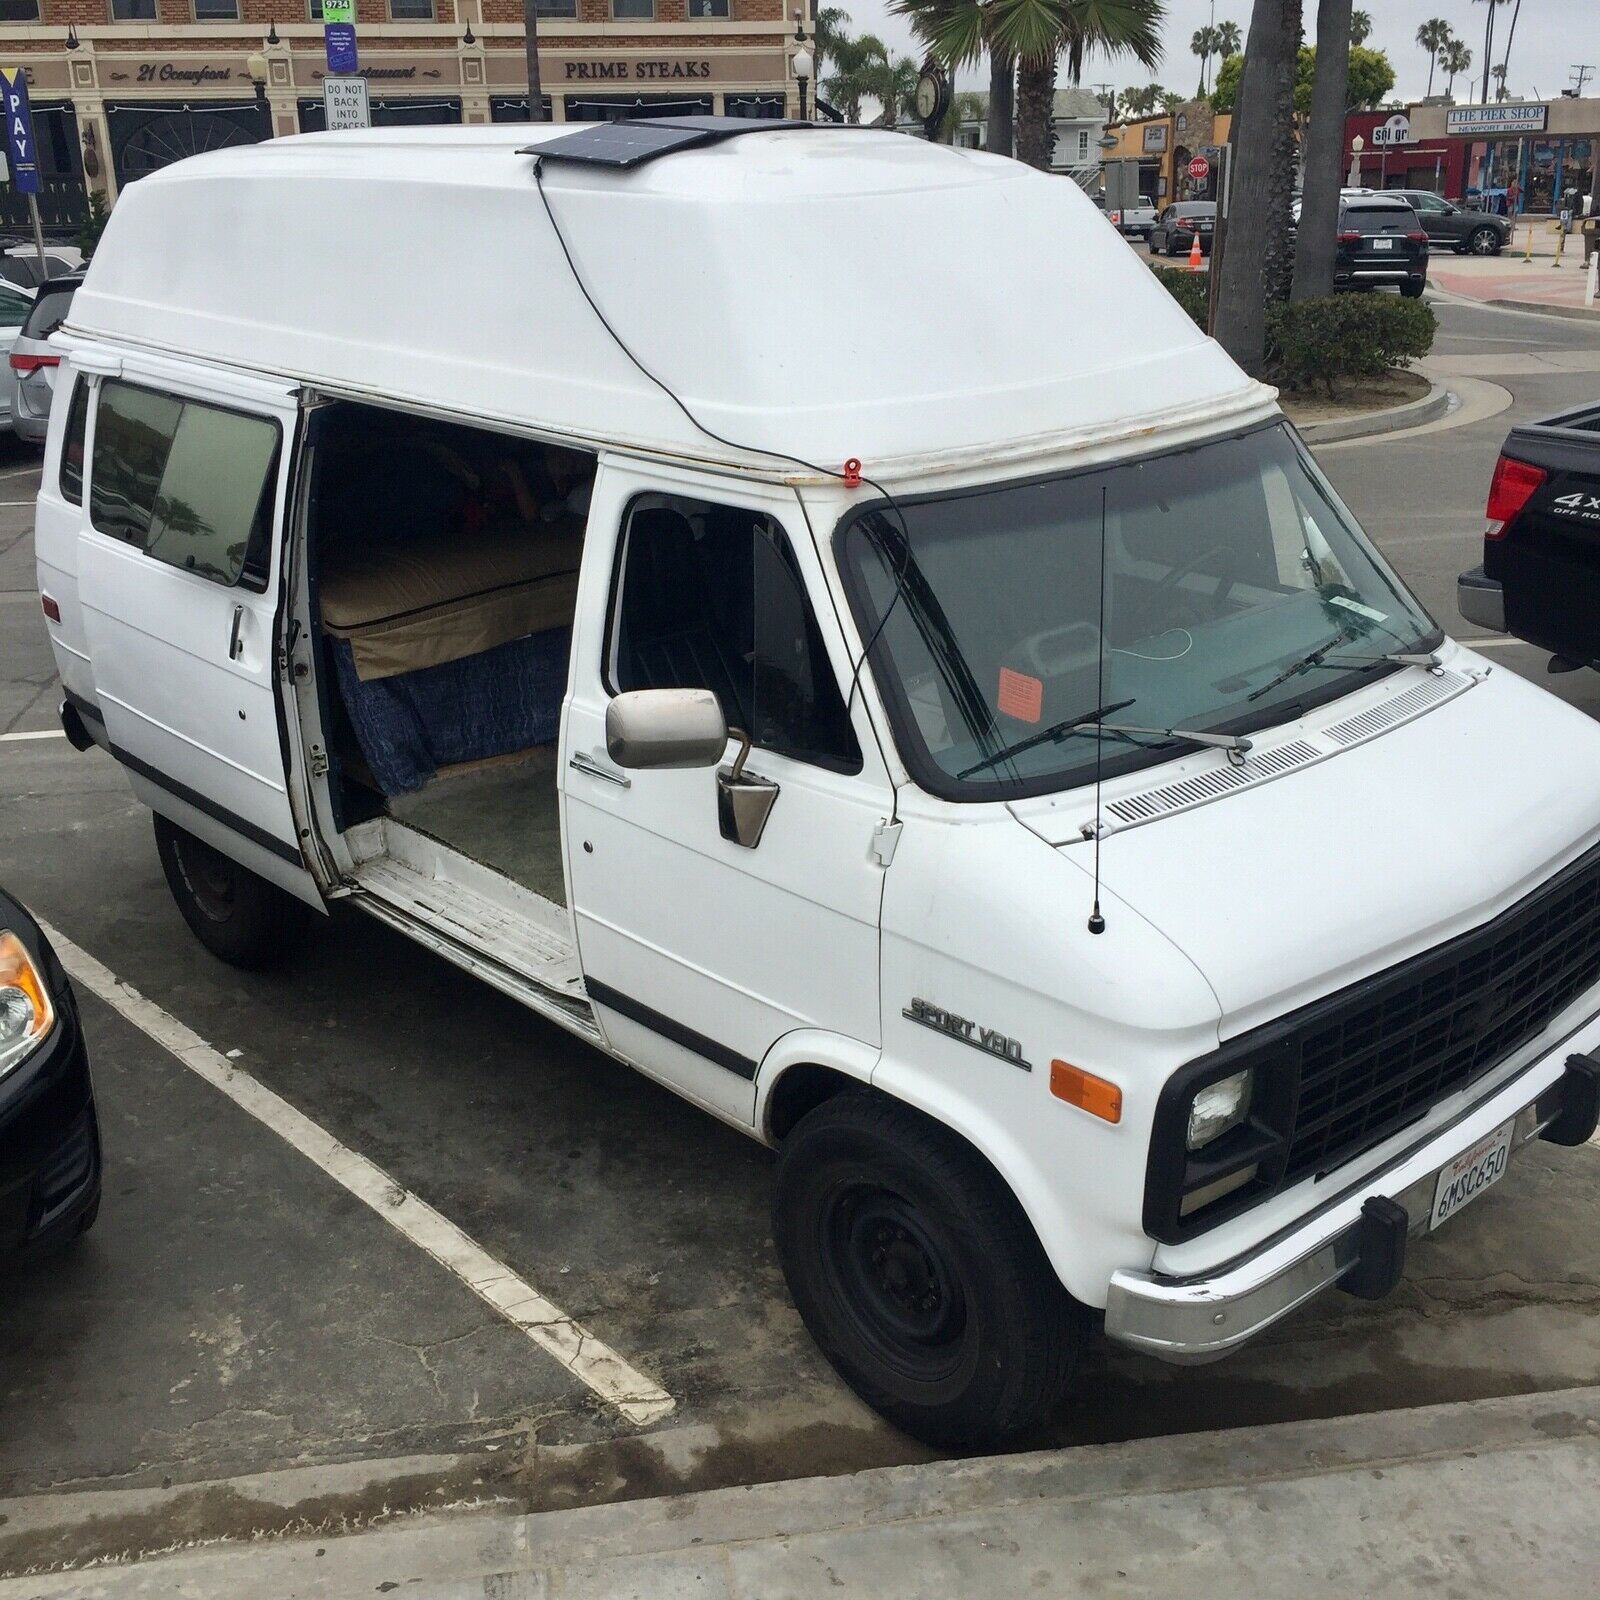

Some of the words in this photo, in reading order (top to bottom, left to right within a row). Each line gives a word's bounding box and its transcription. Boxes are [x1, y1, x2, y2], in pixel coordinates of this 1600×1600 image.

[326, 0, 349, 8] 9734
[136, 64, 156, 80] 21
[160, 64, 230, 85] Oceanfront
[359, 66, 416, 78] staurant
[565, 62, 628, 78] PRIME
[636, 61, 711, 77] STEAKS
[328, 85, 341, 94] DO
[345, 85, 362, 94] NOT
[334, 97, 359, 107] BACK
[336, 109, 358, 118] INTO
[1450, 110, 1476, 122] THE
[1480, 109, 1506, 120] PIER
[1511, 107, 1543, 118] SHOP
[9, 94, 26, 158] PAY
[1458, 124, 1500, 132] NEWPORT
[1190, 163, 1207, 173] STOP
[1581, 512, 1600, 520] RO
[1438, 1145, 1506, 1217] 6MSC650
